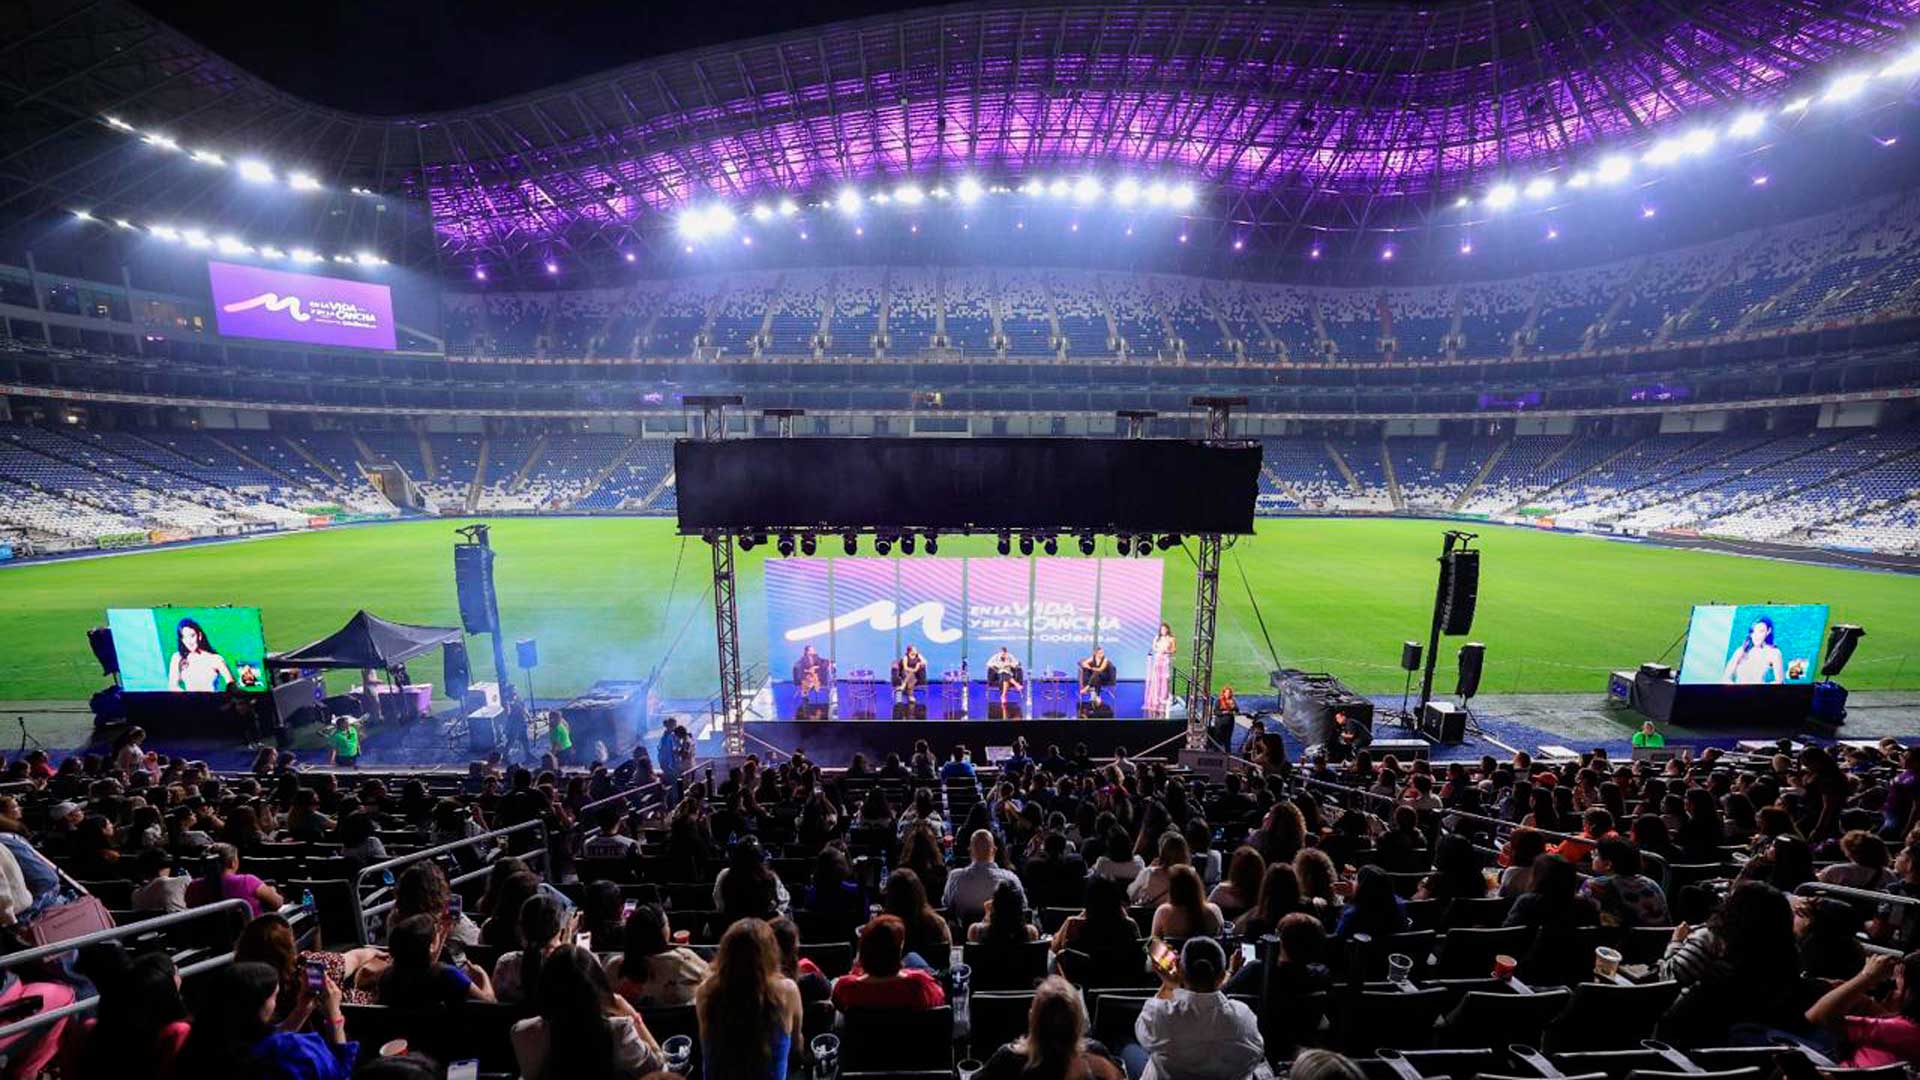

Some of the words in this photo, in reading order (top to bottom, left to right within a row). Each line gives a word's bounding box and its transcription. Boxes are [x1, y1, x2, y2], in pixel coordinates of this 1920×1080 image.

[329, 301, 357, 312] VIDA
[335, 310, 376, 321] CANCHA
[1012, 601, 1075, 616] VIDA
[1023, 615, 1121, 632] CANCHA
